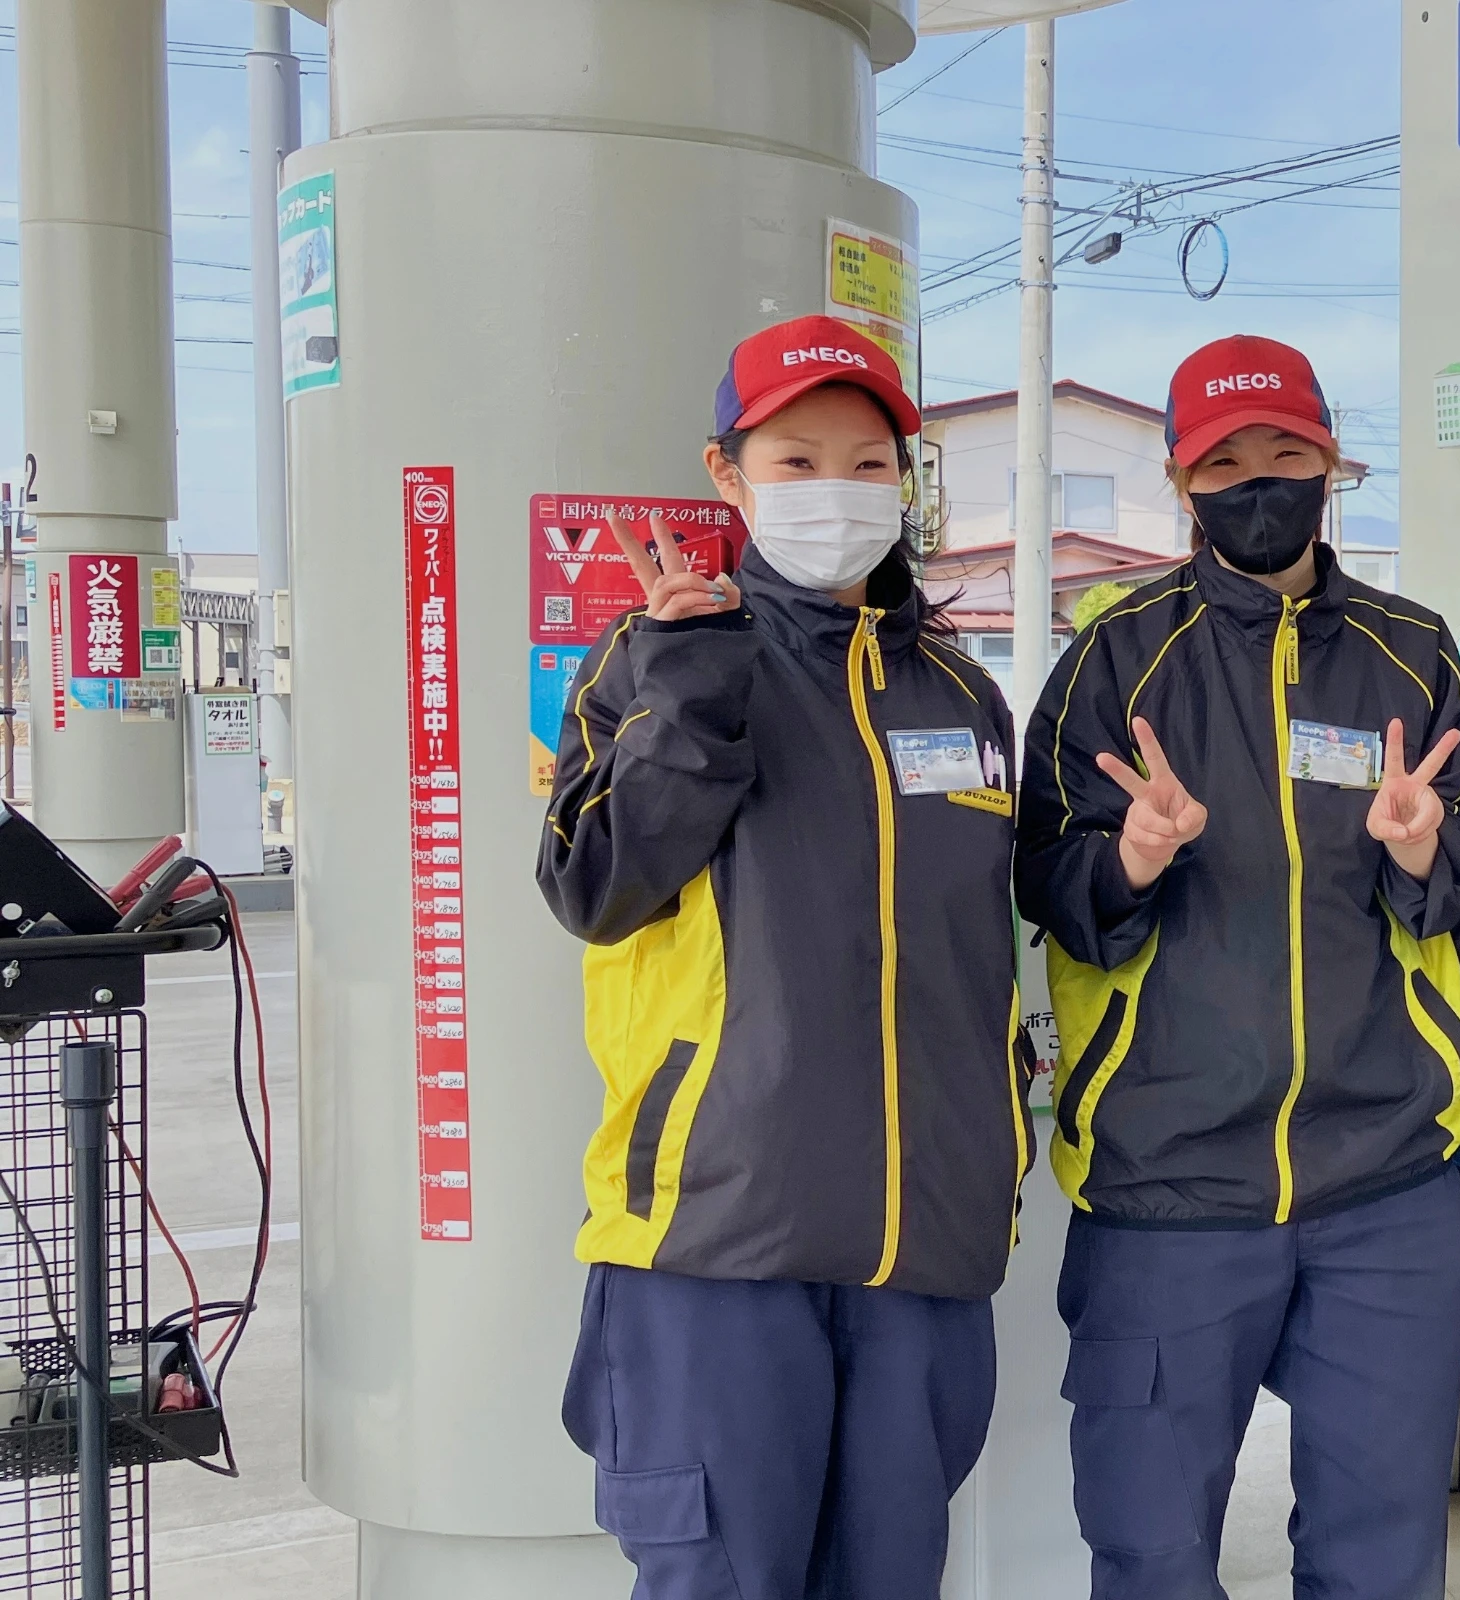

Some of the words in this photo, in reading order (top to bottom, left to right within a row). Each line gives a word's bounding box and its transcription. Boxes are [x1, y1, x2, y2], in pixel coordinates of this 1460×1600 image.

[782, 346, 868, 369] ENEOS
[1205, 372, 1282, 397] ENEOS
[26, 453, 38, 502] 2
[416, 500, 446, 509] ENEOS
[562, 501, 731, 527] 国内最高クラスの性能
[546, 552, 596, 562] VICTORY
[598, 553, 630, 563] FORC
[87, 559, 124, 675] 火気厳禁
[208, 709, 248, 721] タオル
[416, 776, 431, 784] 300
[965, 791, 1007, 806] DUNLOP
[417, 801, 432, 809] 325
[417, 826, 432, 835] 350
[418, 851, 432, 860] 375
[419, 876, 433, 884] 400
[420, 901, 434, 909] 425
[420, 926, 434, 934] 450
[421, 951, 435, 959] 475
[421, 976, 435, 984] 500
[422, 1001, 436, 1009] 525
[422, 1025, 437, 1034] 550
[424, 1075, 438, 1084] 600
[425, 1125, 440, 1133] 650
[427, 1175, 441, 1183] 700
[427, 1224, 442, 1233] 750
